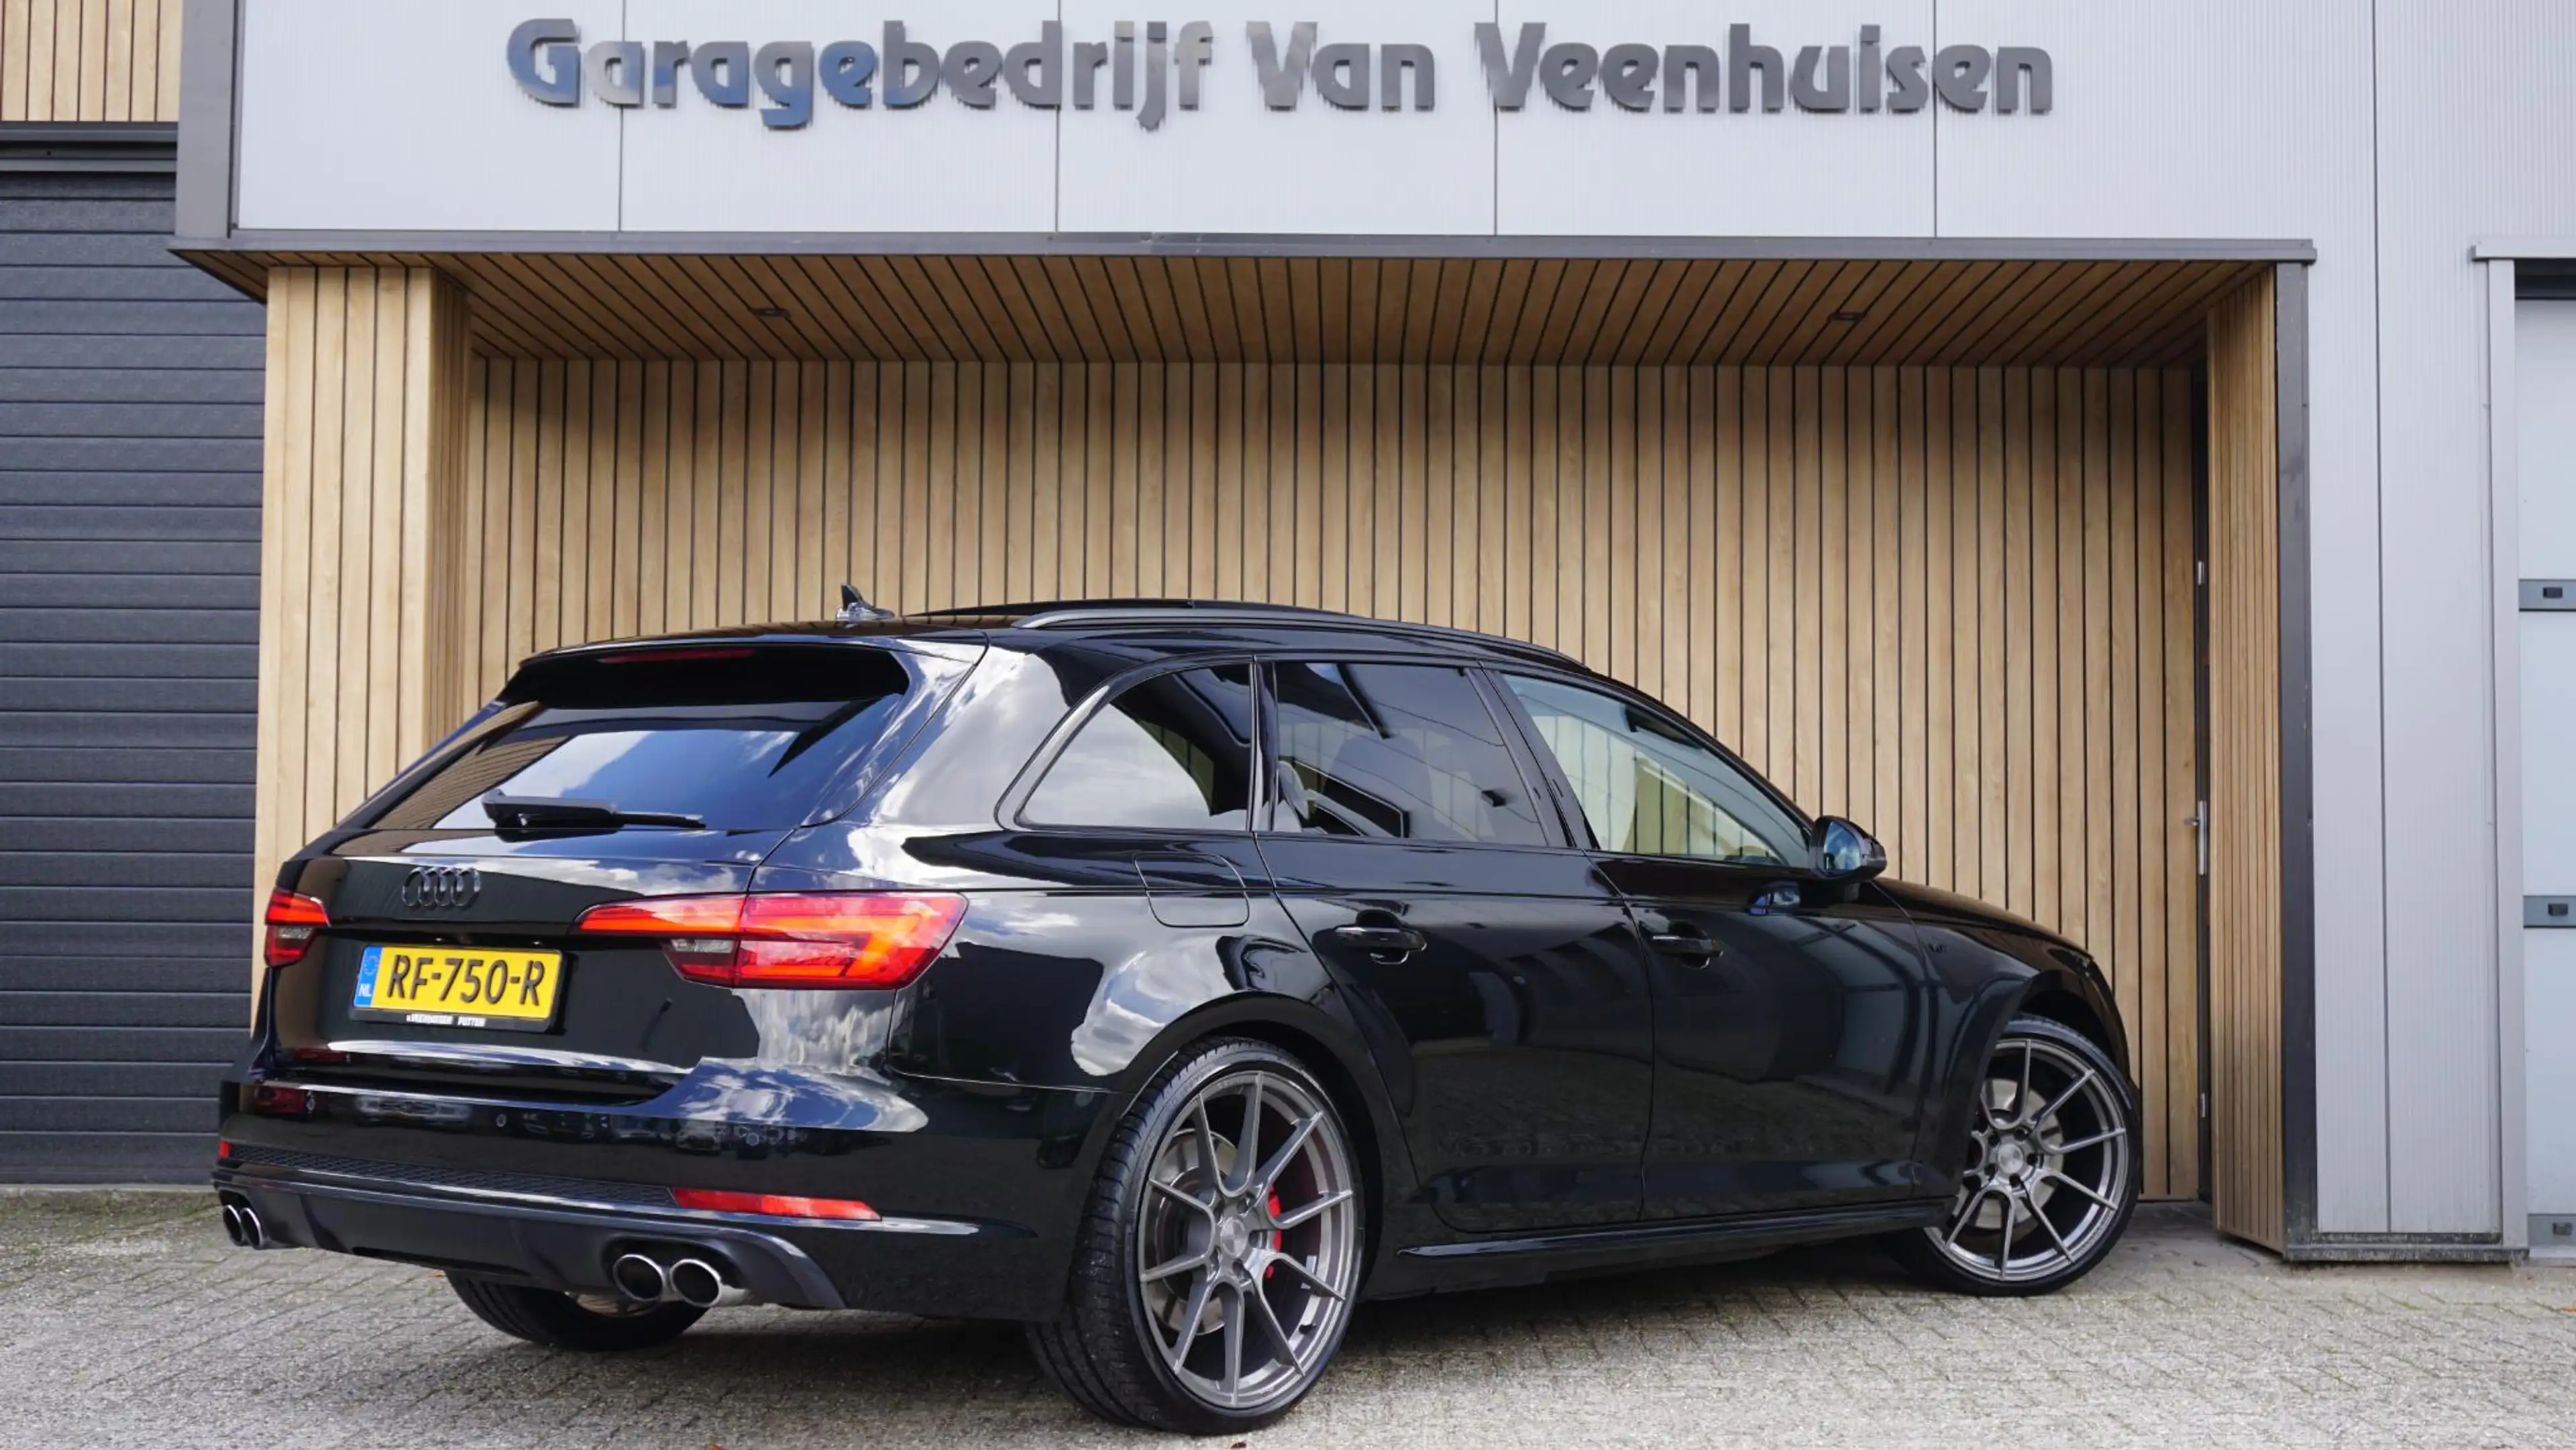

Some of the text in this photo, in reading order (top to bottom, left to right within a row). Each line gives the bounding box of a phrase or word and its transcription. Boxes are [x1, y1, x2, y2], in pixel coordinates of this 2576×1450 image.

[507, 18, 2053, 132] Garagebedrijf Van Veenhuisen
[358, 982, 372, 997] NL
[386, 954, 545, 1006] RF-750-R
